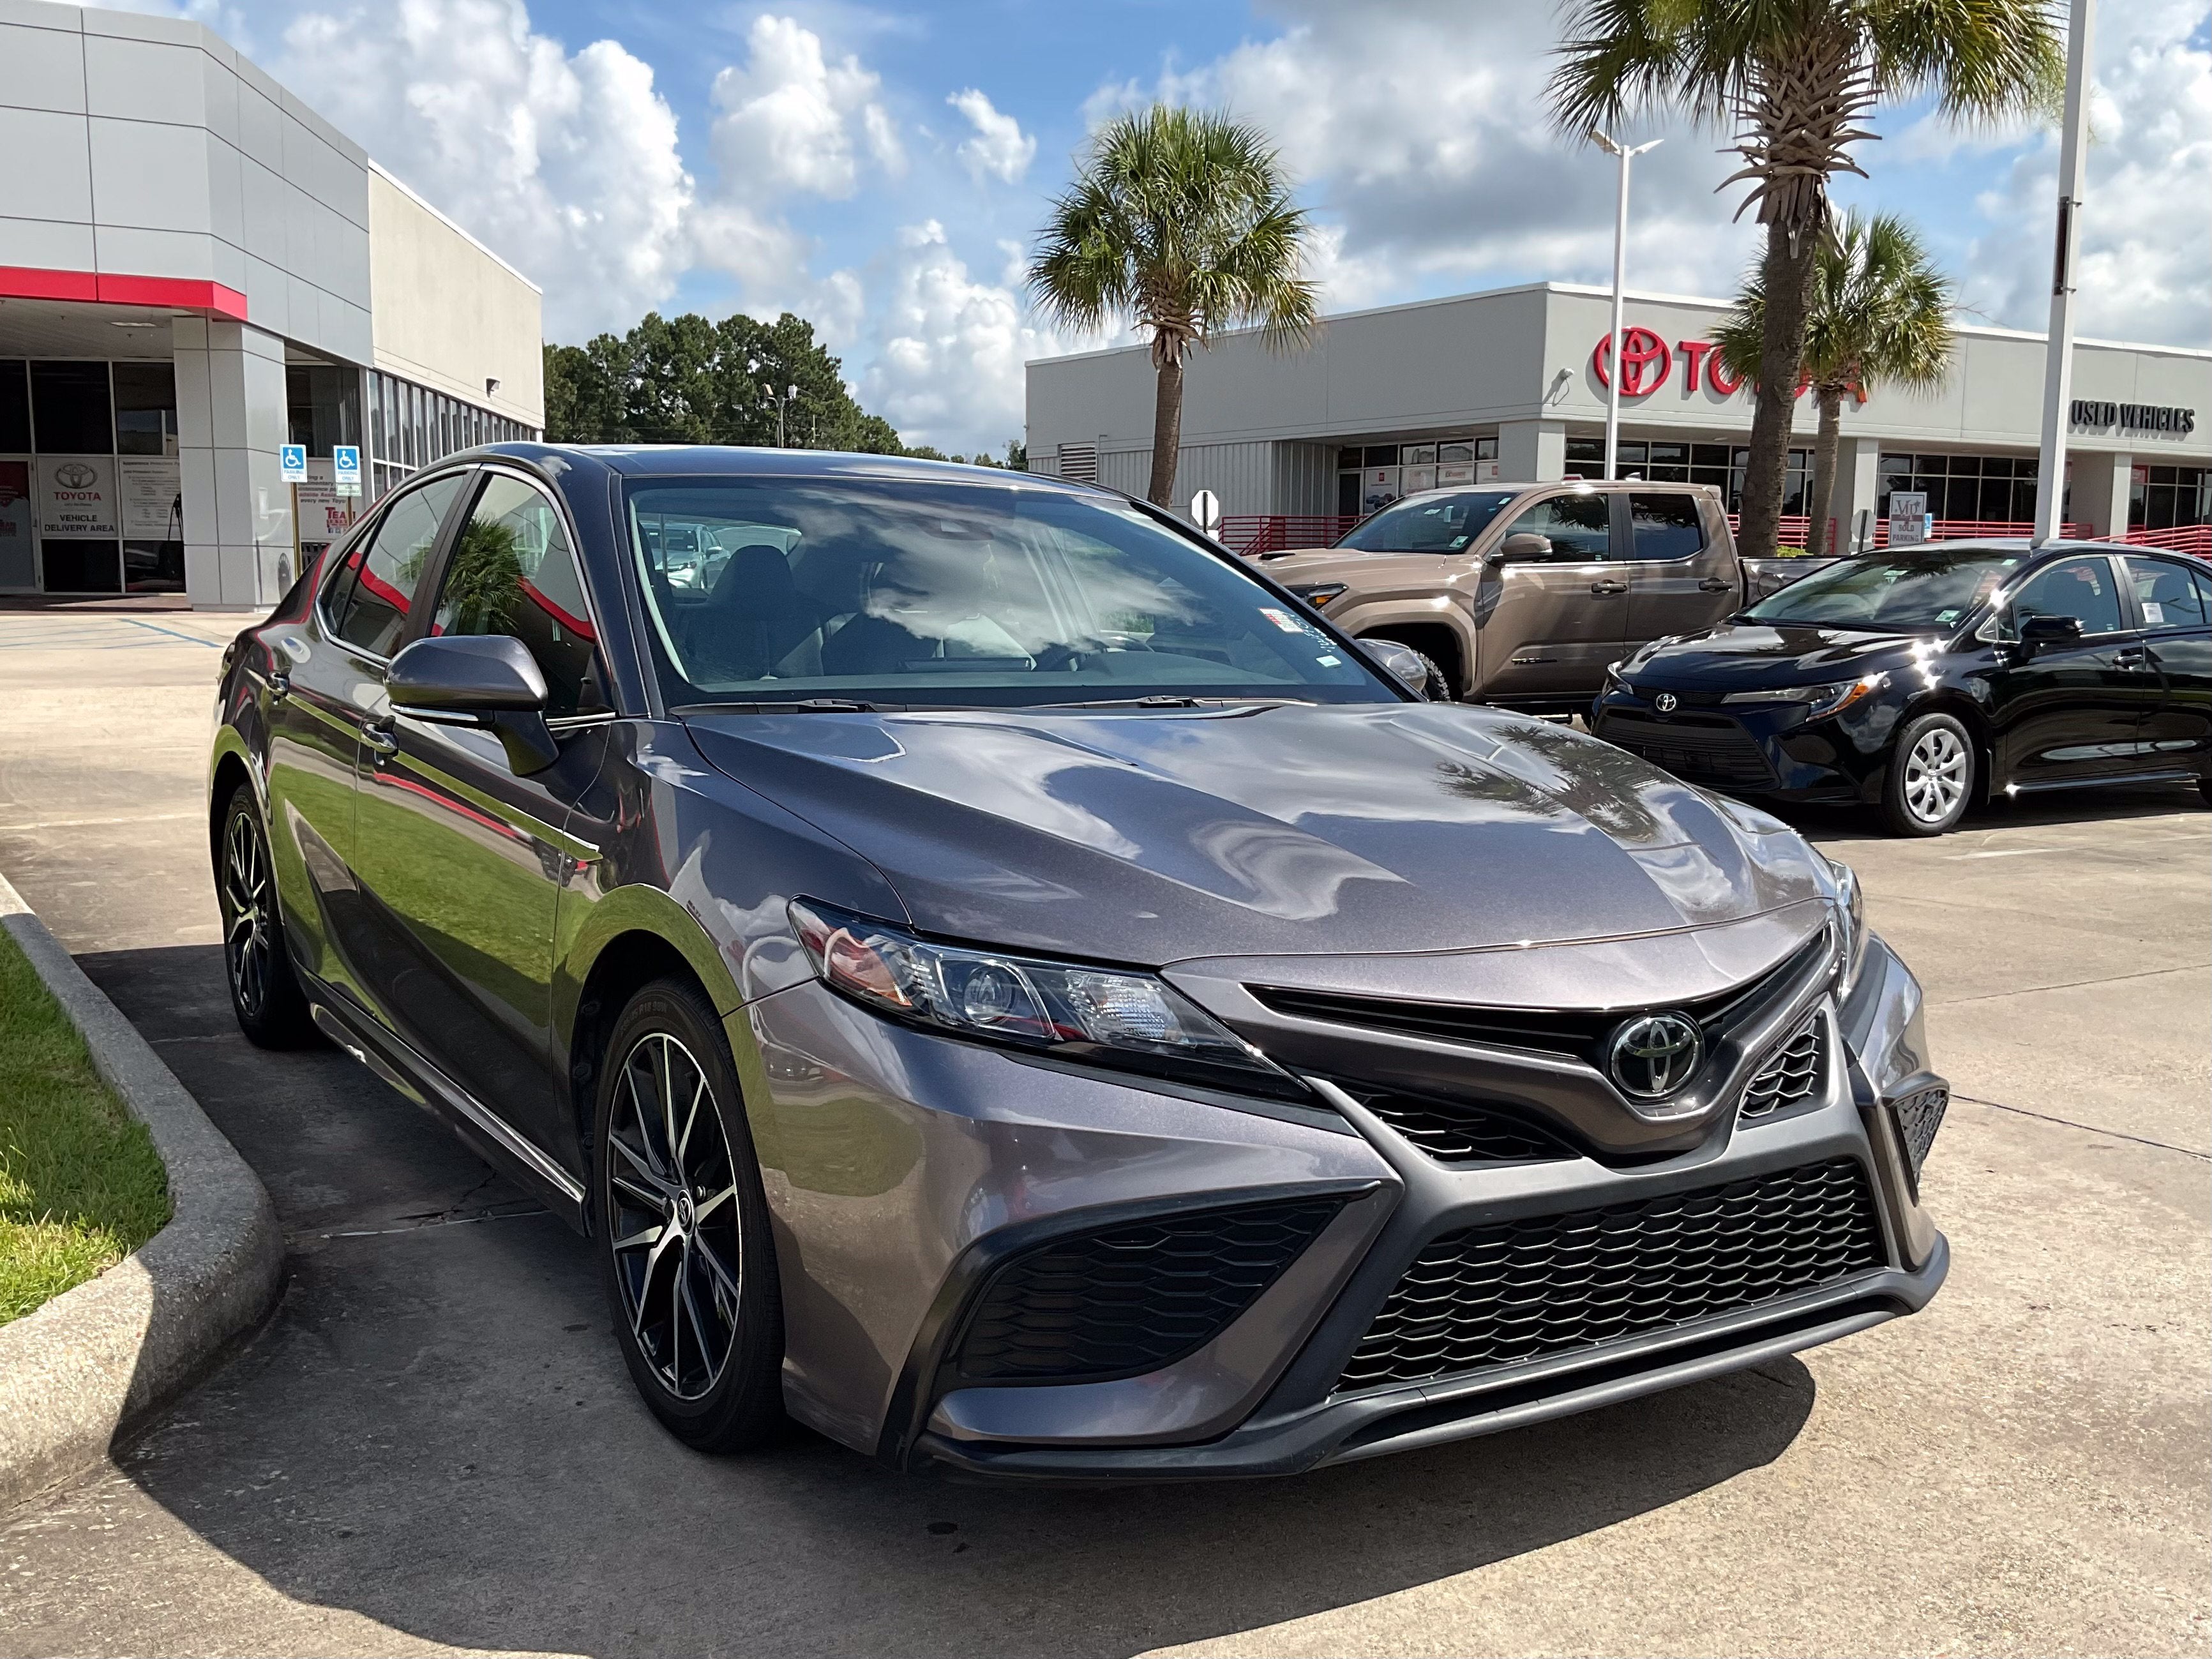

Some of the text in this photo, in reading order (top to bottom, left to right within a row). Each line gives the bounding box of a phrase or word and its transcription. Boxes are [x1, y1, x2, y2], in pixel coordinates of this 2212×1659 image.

[2072, 400, 2195, 433] USED VEHICLES
[54, 492, 102, 500] TOYOTA
